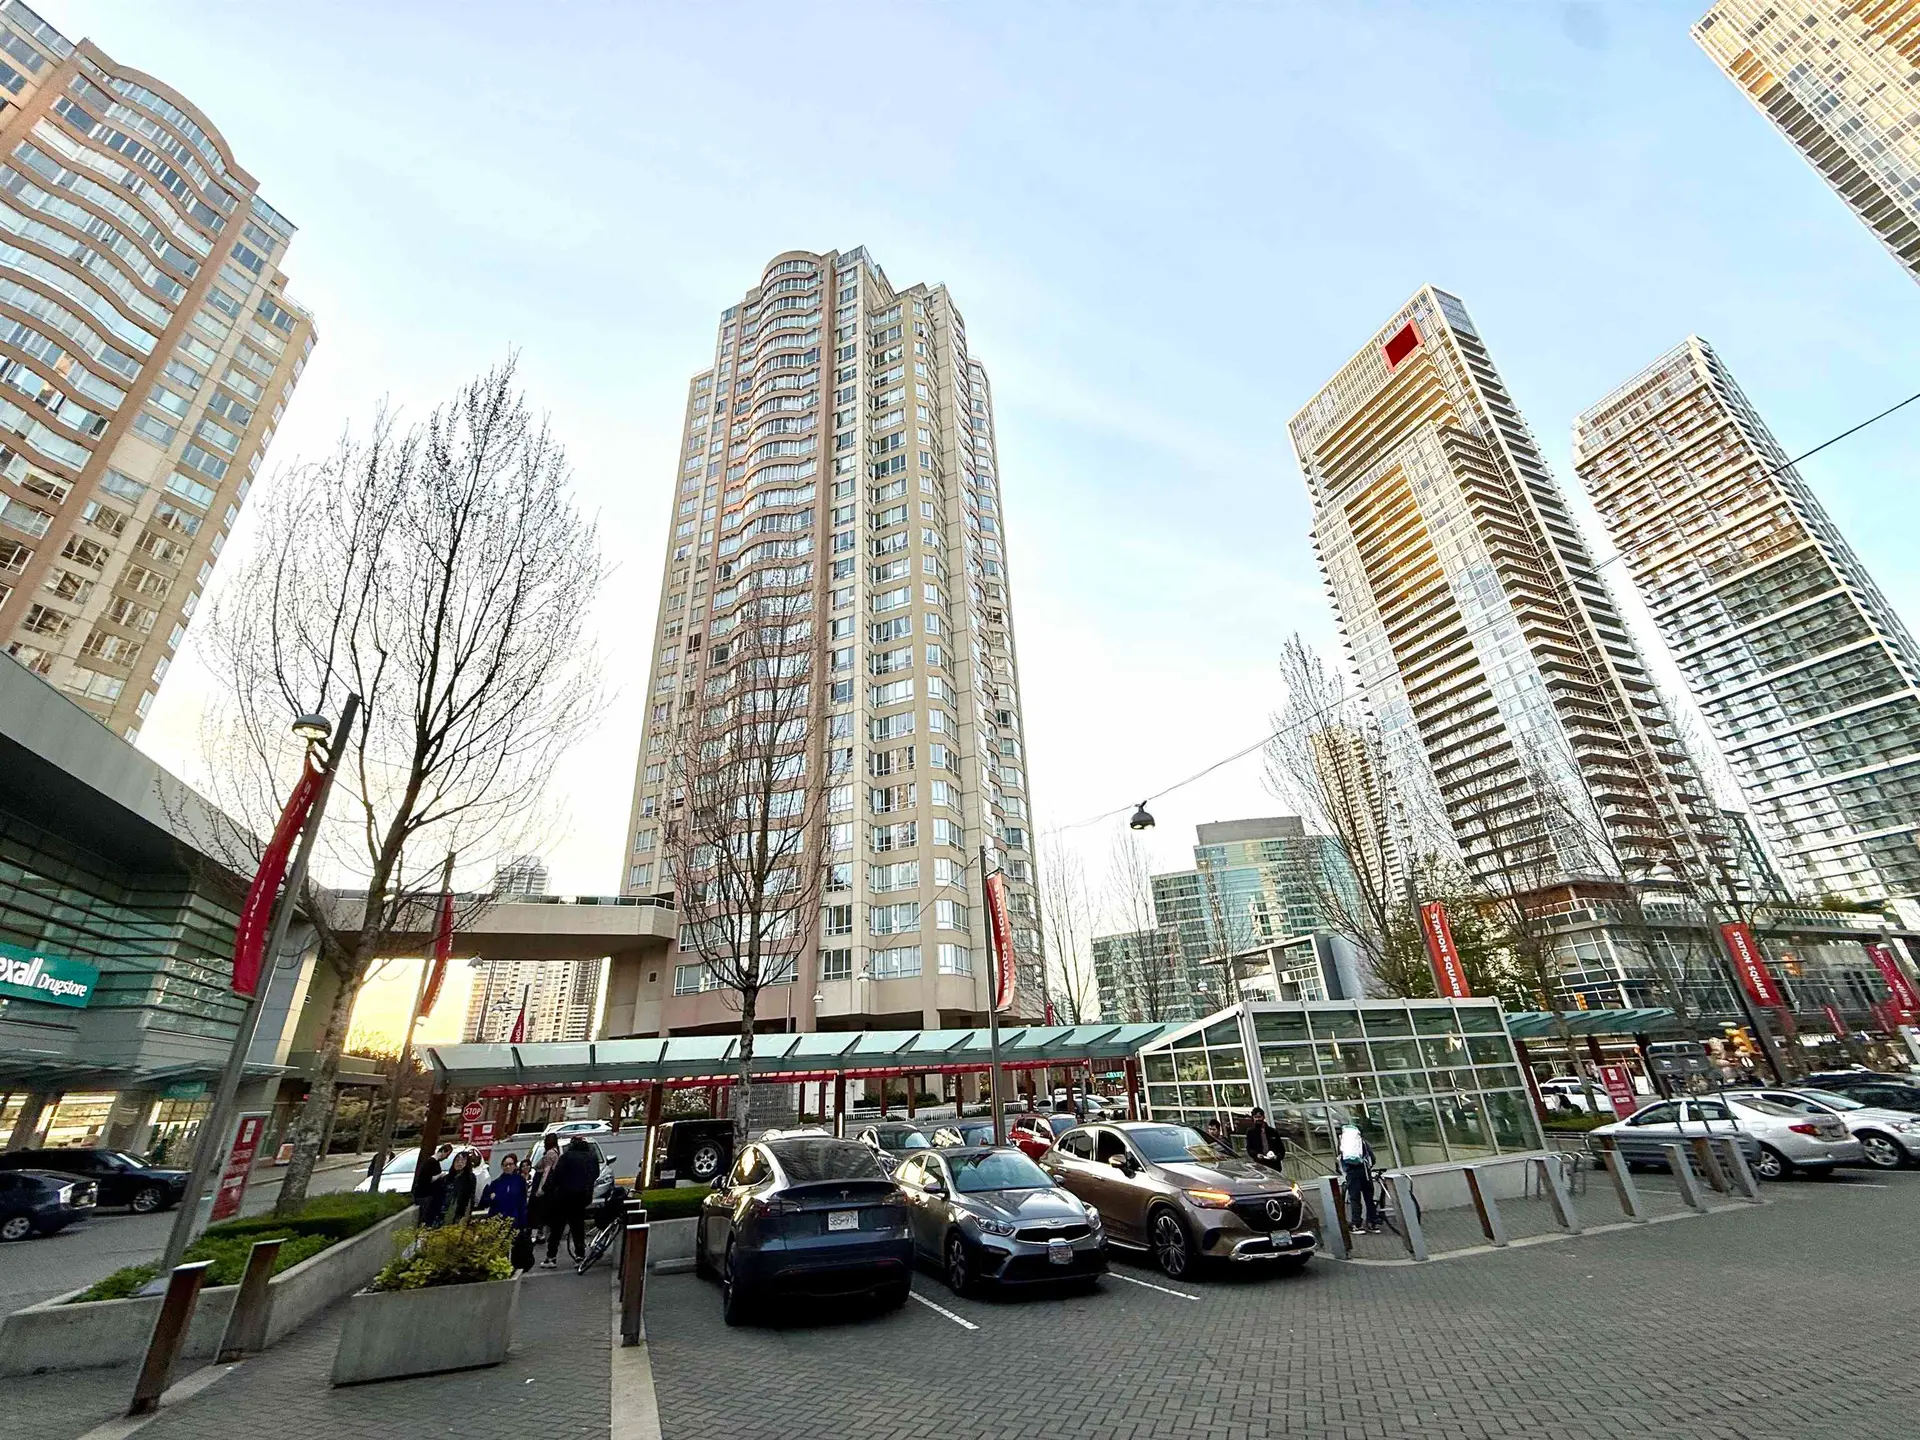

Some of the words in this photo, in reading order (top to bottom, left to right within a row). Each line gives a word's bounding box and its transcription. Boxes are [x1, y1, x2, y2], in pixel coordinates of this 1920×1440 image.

[993, 883, 1006, 937] STATION
[1001, 942, 1010, 998] SQUARE
[1430, 913, 1448, 953] STATION
[1443, 955, 1462, 997] SQUARE
[1732, 931, 1753, 964] STATION
[1748, 965, 1770, 999] SQUARE
[37, 973, 88, 997] Drugstore
[464, 1107, 481, 1116] STOP
